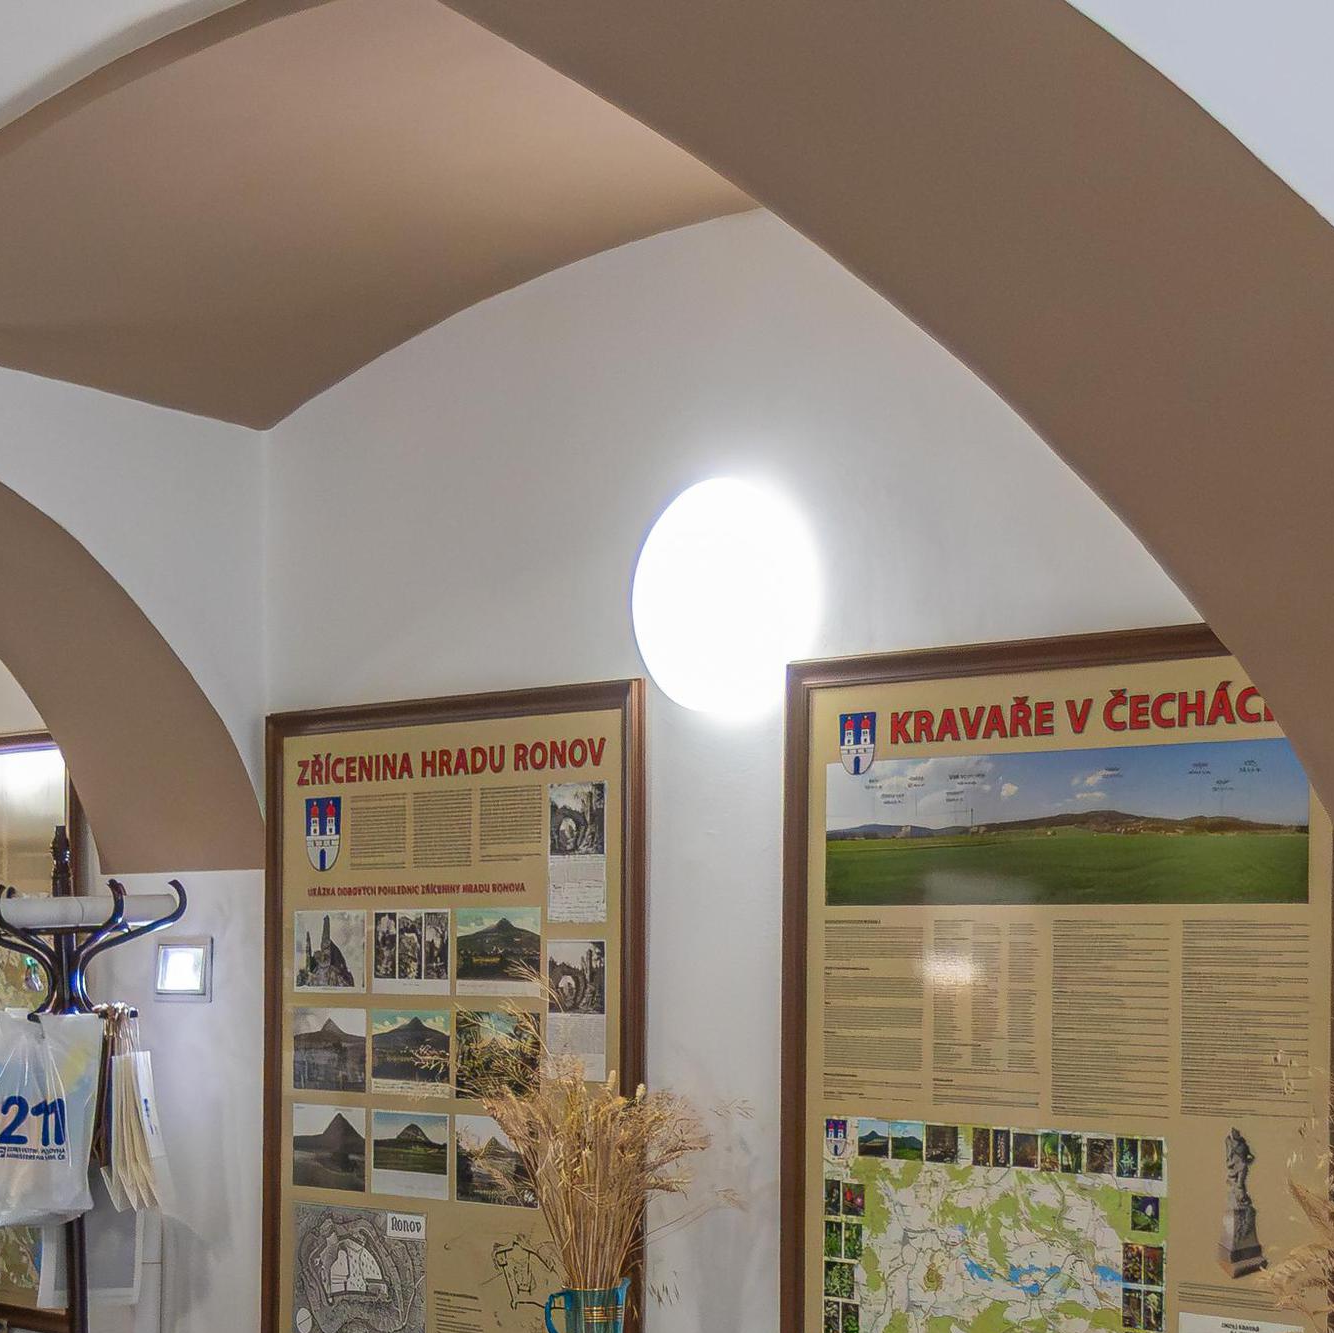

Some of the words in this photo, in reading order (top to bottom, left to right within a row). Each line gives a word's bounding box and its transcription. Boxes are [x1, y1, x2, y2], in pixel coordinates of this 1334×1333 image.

[889, 696, 1056, 745] KRAVAŘE
[1064, 697, 1094, 734] V
[296, 752, 414, 787] ZŘÍCENINA
[420, 745, 506, 779] HRADU
[513, 737, 607, 772] RONOV
[462, 882, 490, 894] HRADU
[391, 1215, 422, 1233] Ronov
